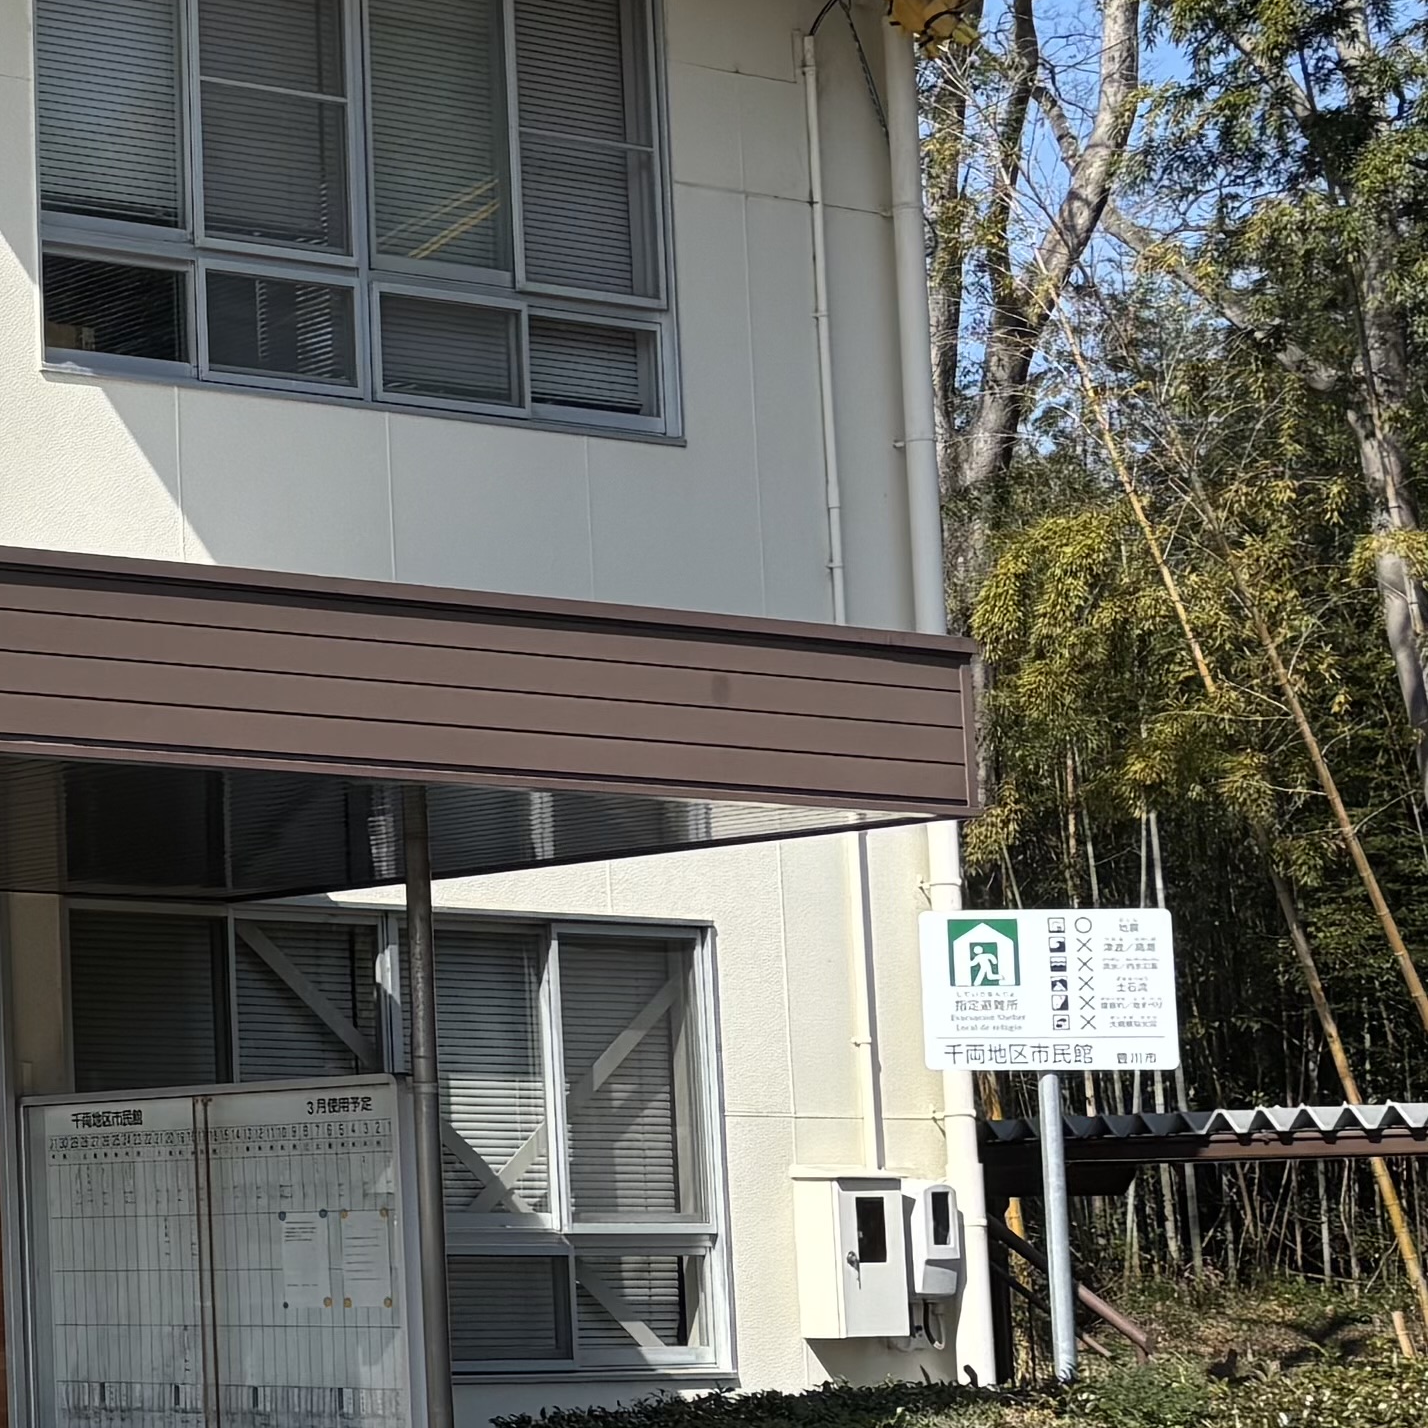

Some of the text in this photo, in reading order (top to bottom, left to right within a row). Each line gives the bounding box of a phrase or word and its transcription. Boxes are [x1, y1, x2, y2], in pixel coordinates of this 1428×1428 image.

[955, 999, 1018, 1011] 指定避難所
[944, 1043, 1157, 1064] 千両地区市民館 豊川市
